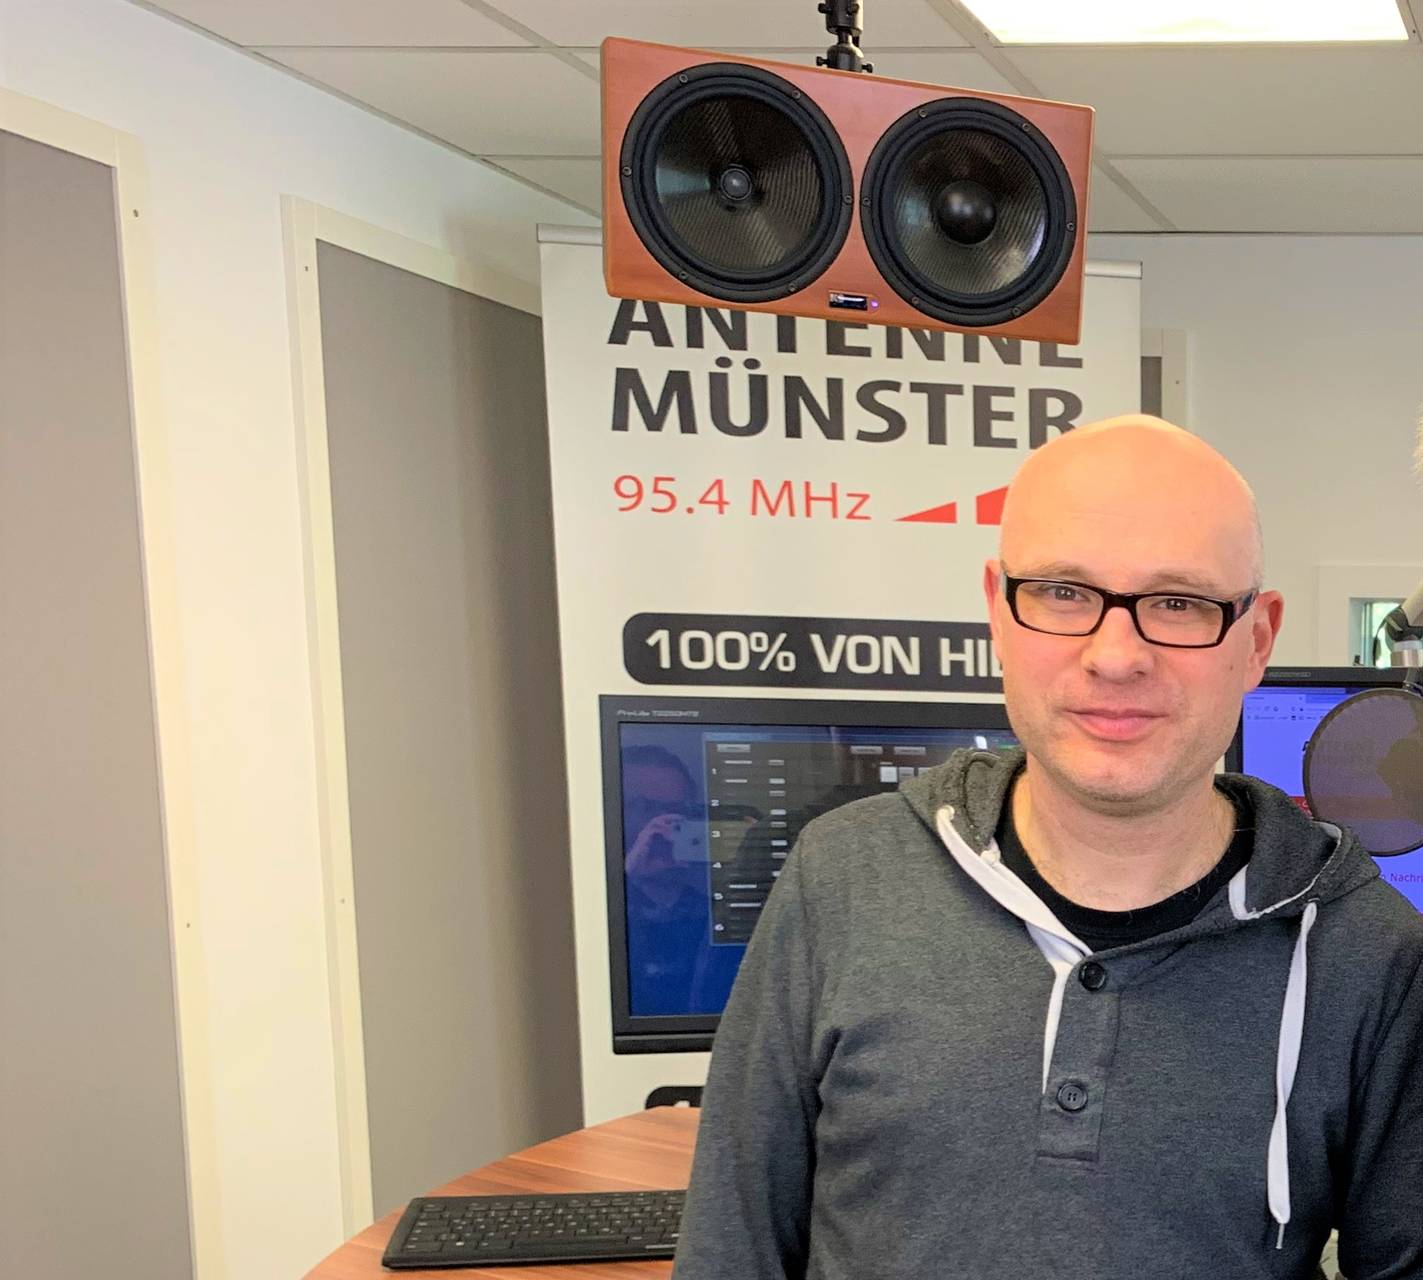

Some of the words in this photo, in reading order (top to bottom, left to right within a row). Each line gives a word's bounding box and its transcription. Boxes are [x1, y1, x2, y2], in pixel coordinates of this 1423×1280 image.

[612, 356, 1083, 450] MÜNSTER
[613, 474, 730, 515] 95.4
[750, 479, 872, 521] MHz
[645, 629, 797, 672] 100%
[810, 633, 921, 675] VON
